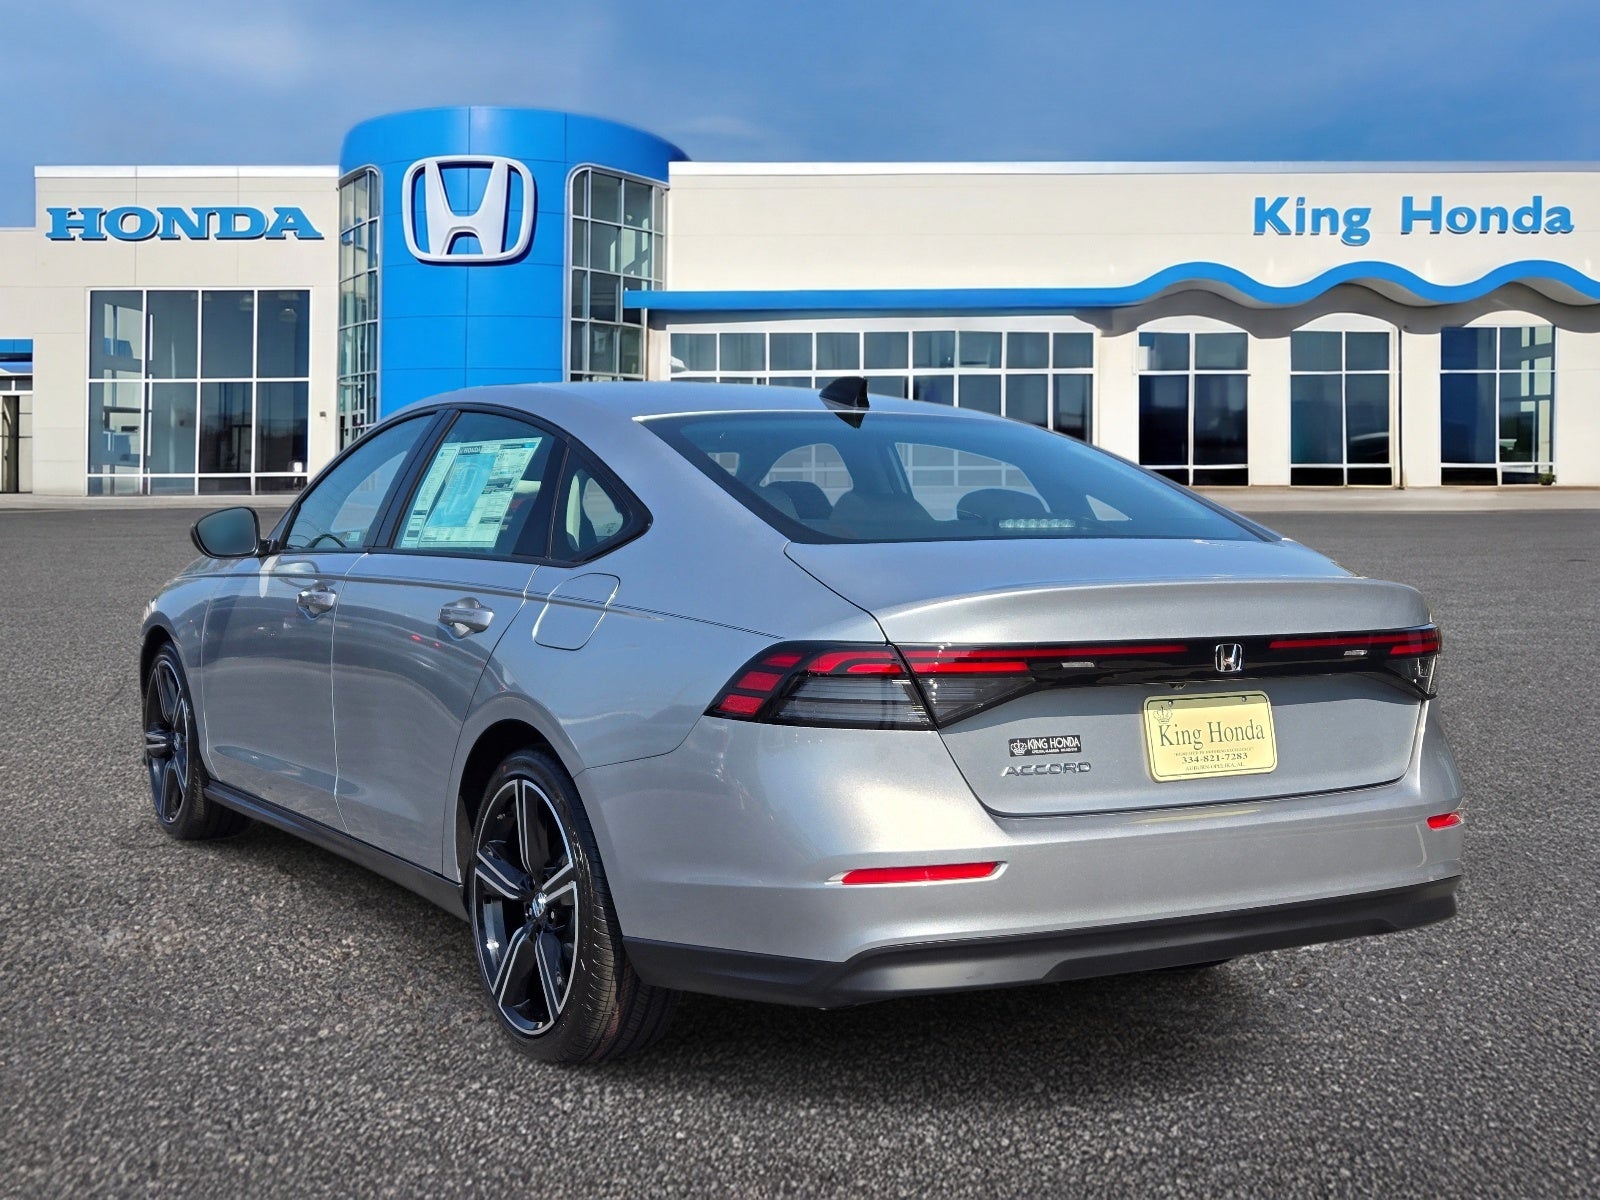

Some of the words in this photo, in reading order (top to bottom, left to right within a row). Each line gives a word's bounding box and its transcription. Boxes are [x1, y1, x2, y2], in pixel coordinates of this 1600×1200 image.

[46, 206, 324, 241] HONDA
[1254, 196, 1372, 247] King
[1400, 195, 1575, 235] Honda
[1028, 738, 1048, 750] KING
[1050, 736, 1080, 749] HONDA
[1159, 723, 1203, 750] King
[1207, 719, 1265, 743] Honda
[1001, 761, 1092, 777] ACCORD
[1182, 752, 1248, 764] 334-821-7283
